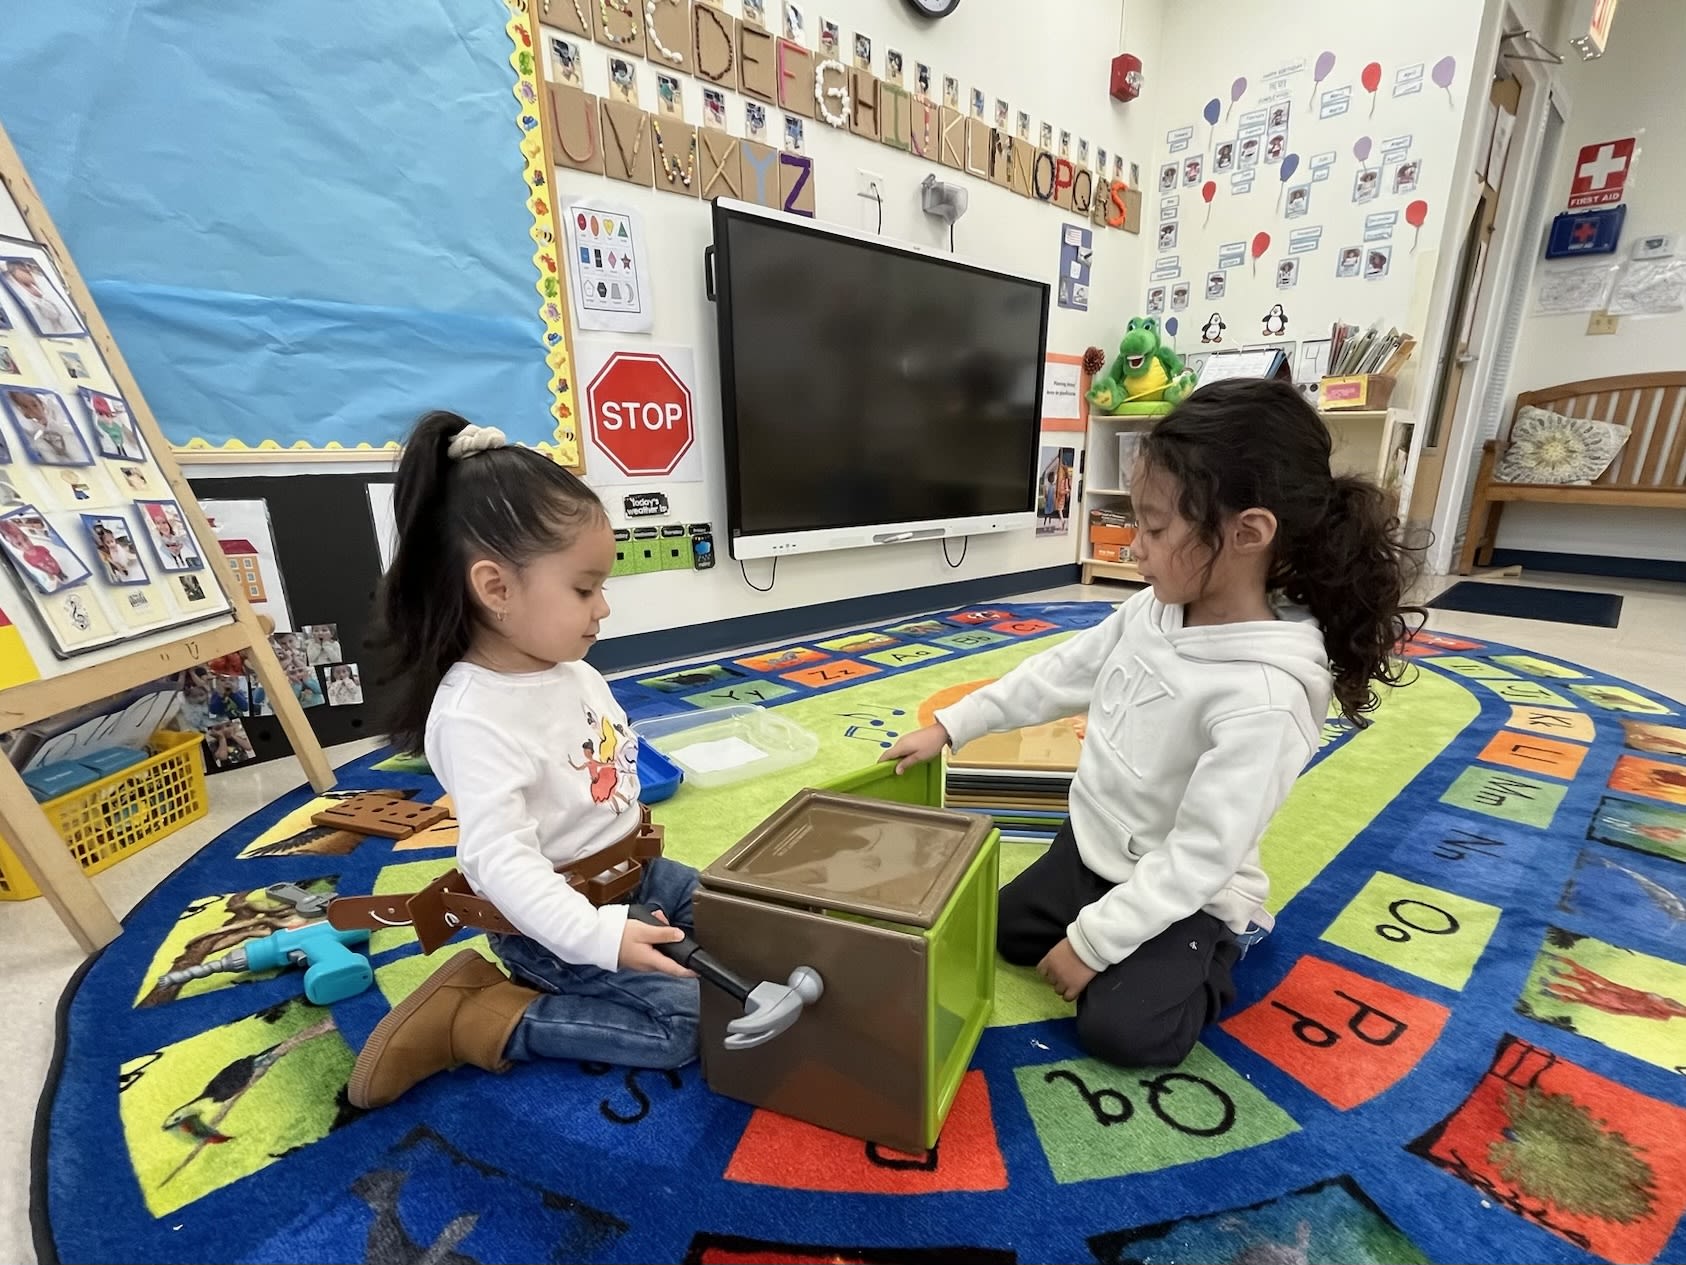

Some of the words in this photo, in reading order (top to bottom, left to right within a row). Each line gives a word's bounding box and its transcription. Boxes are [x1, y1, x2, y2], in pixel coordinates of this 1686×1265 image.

[646, 0, 684, 64] C
[695, 3, 734, 81] D
[741, 26, 773, 99] E
[778, 39, 809, 105] F
[815, 59, 851, 128] G
[853, 74, 879, 136] H
[882, 84, 911, 151] I
[940, 113, 963, 168] K
[965, 117, 987, 176] L
[1013, 136, 1032, 197] N
[1034, 152, 1055, 201] O
[1053, 158, 1074, 201] P
[1073, 169, 1092, 212] Q
[1109, 179, 1129, 227] S
[551, 89, 595, 163] U
[603, 102, 647, 179] V
[653, 120, 697, 188] W
[702, 133, 740, 198] X
[742, 142, 778, 207] Y
[779, 152, 814, 219] Z
[1570, 195, 1600, 206] FIRST
[1602, 193, 1620, 201] AID
[601, 400, 683, 431] STOP
[626, 506, 659, 516] weather
[629, 497, 660, 508] Today's
[952, 635, 992, 646] Bb
[890, 650, 931, 663] Aa
[807, 668, 857, 682] Zz
[710, 689, 766, 701] Yy
[1528, 711, 1576, 729] Kk
[1472, 775, 1544, 807] Mm
[1431, 828, 1508, 862] Nn
[1374, 898, 1461, 943] Oo
[1270, 989, 1409, 1048] Pp
[1043, 1067, 1237, 1138] Qq
